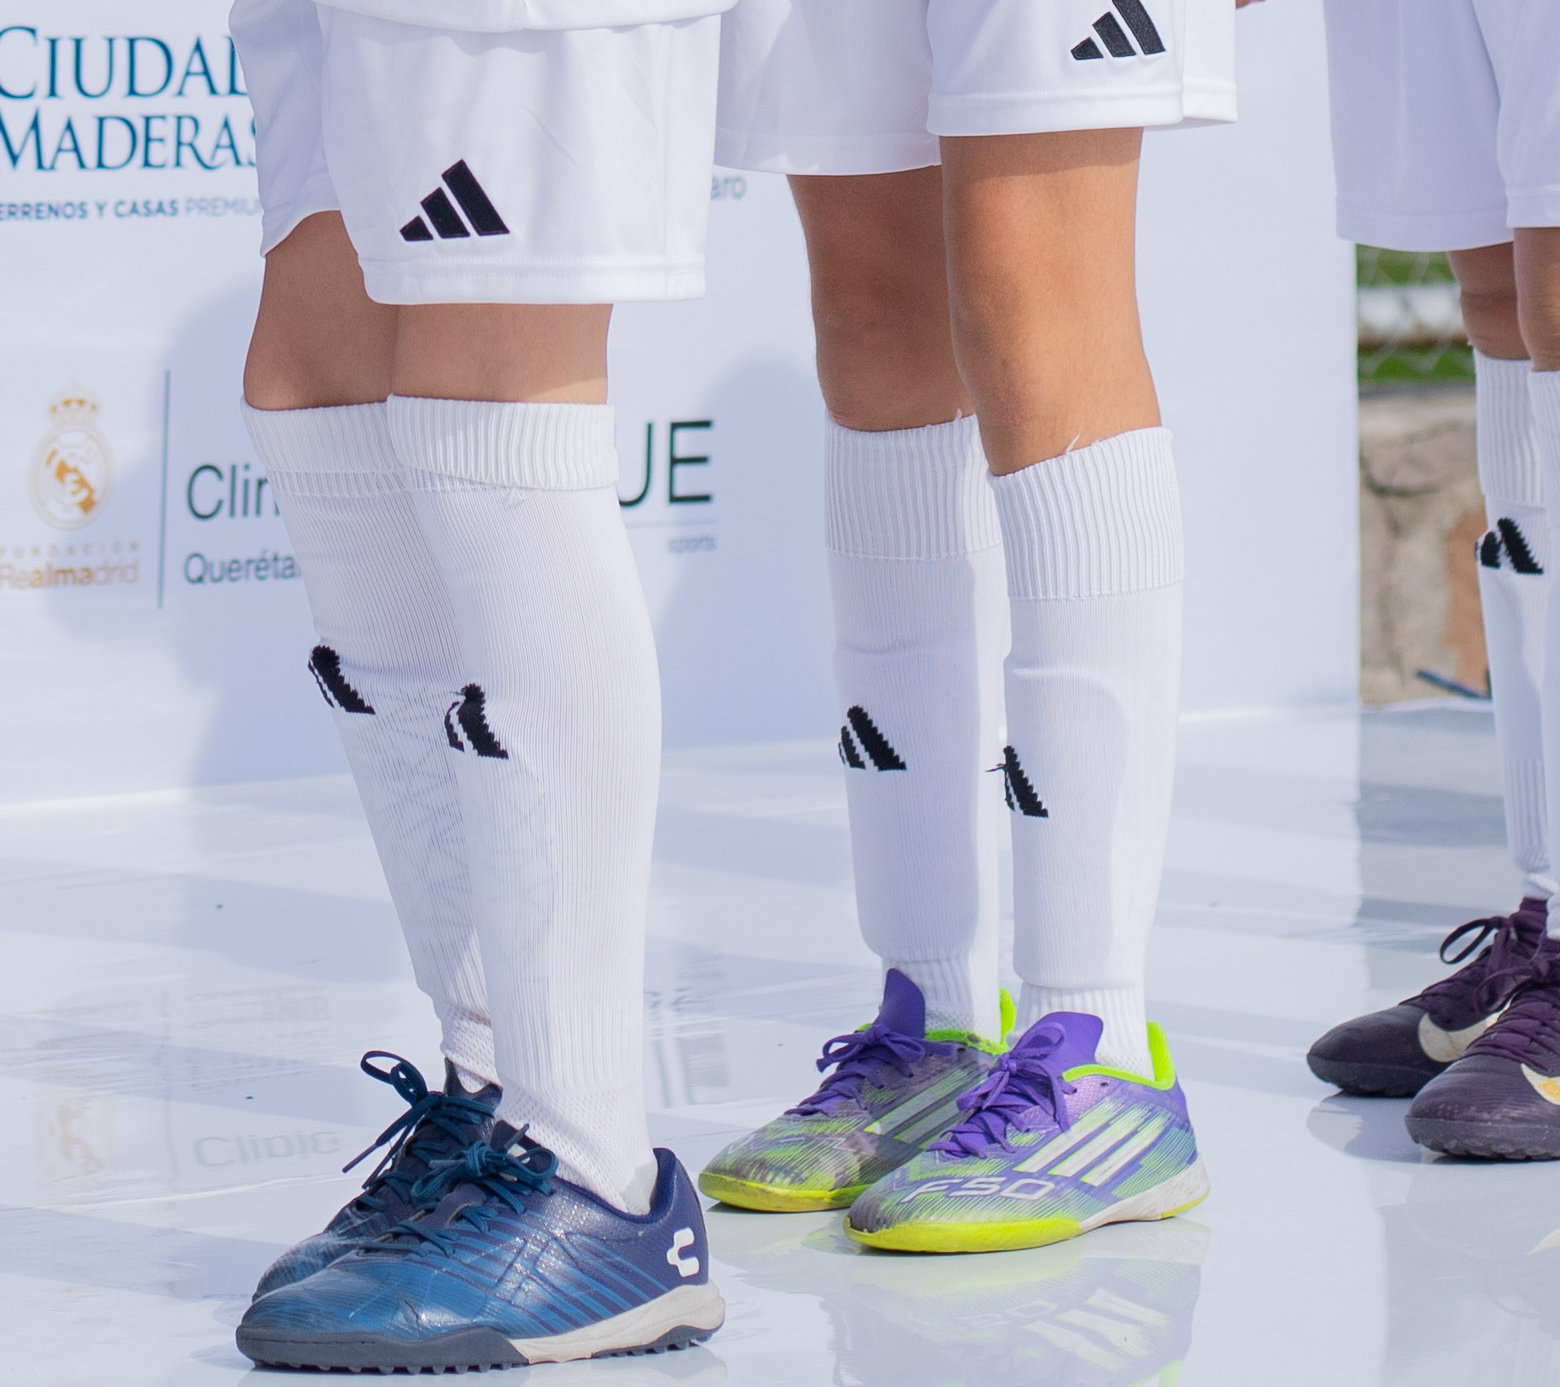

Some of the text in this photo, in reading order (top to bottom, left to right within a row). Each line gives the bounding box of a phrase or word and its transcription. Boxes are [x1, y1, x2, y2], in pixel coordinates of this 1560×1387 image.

[95, 203, 107, 217] Y
[114, 199, 178, 218] CASAS
[185, 198, 262, 217] PREMIU
[186, 463, 280, 521] Clin
[184, 549, 302, 585] Queréta
[900, 1178, 1056, 1204] F50
